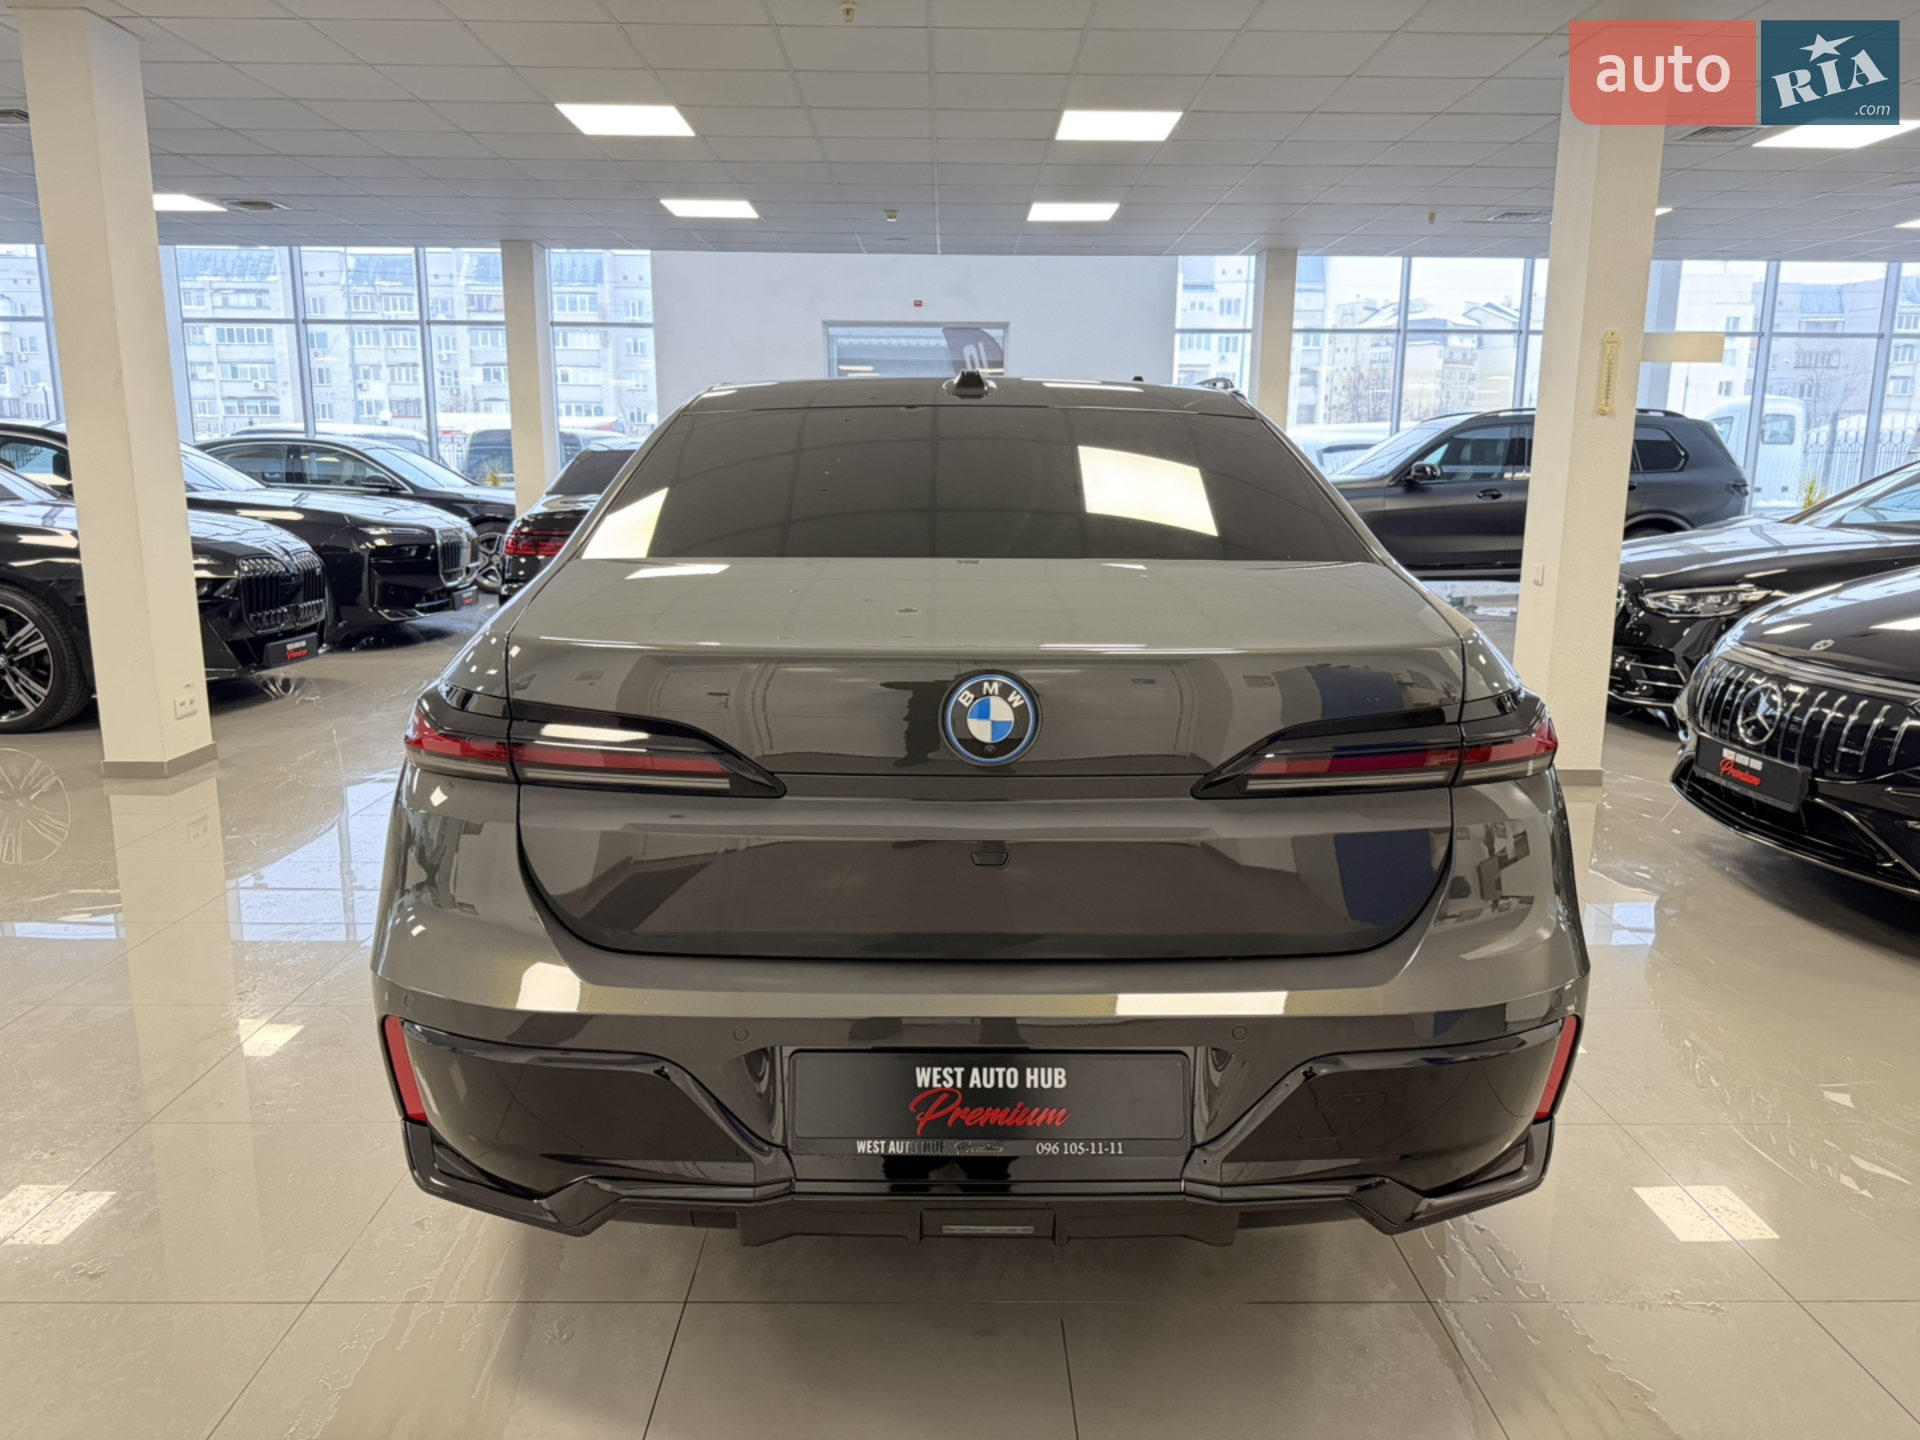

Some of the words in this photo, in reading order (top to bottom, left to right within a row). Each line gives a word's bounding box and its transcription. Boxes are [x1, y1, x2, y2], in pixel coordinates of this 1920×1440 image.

[958, 681, 1025, 708] BMW
[915, 1067, 965, 1088] WEST
[969, 1067, 1020, 1088] AUTO
[1026, 1067, 1067, 1088] HUB
[909, 1088, 1072, 1136] Premium
[856, 1140, 886, 1154] WEST
[1036, 1142, 1060, 1155] 096
[1063, 1142, 1124, 1155] 105-11-11
